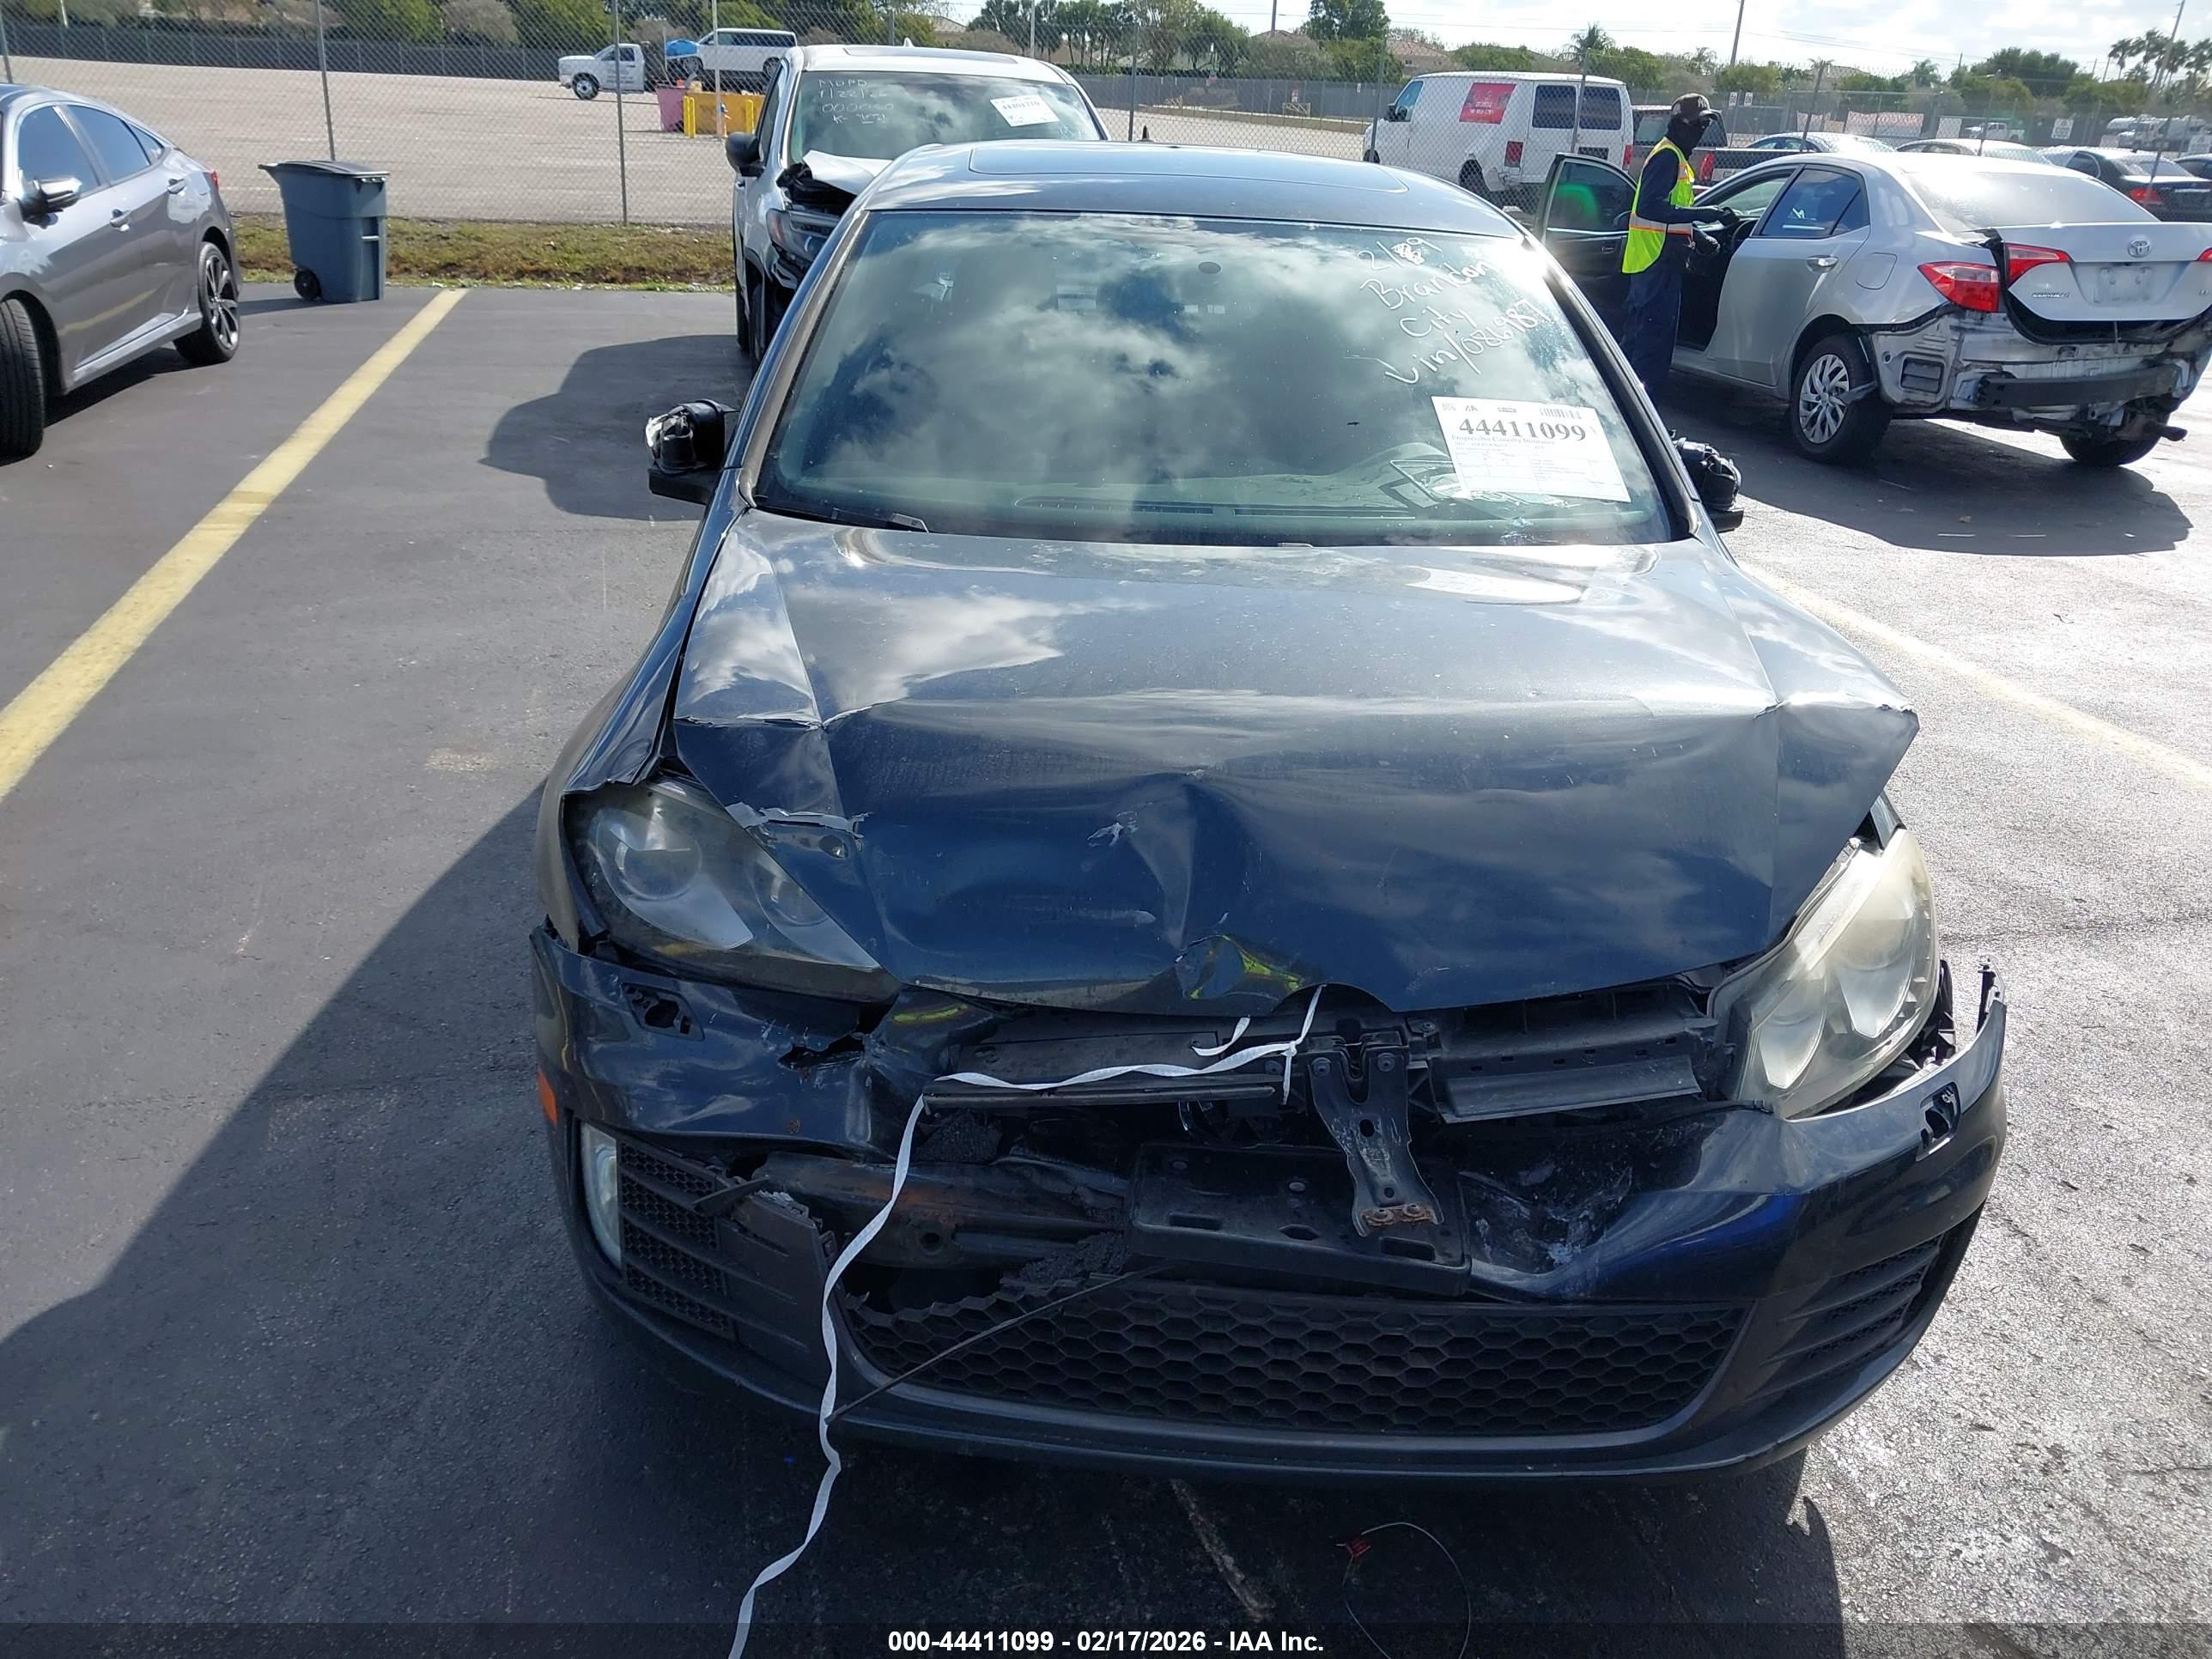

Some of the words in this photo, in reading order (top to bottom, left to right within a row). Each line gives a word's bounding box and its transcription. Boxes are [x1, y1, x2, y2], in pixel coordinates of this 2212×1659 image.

[1359, 260, 1495, 310] Brandon
[1399, 305, 1478, 337] City
[1458, 418, 1587, 441] 44411099
